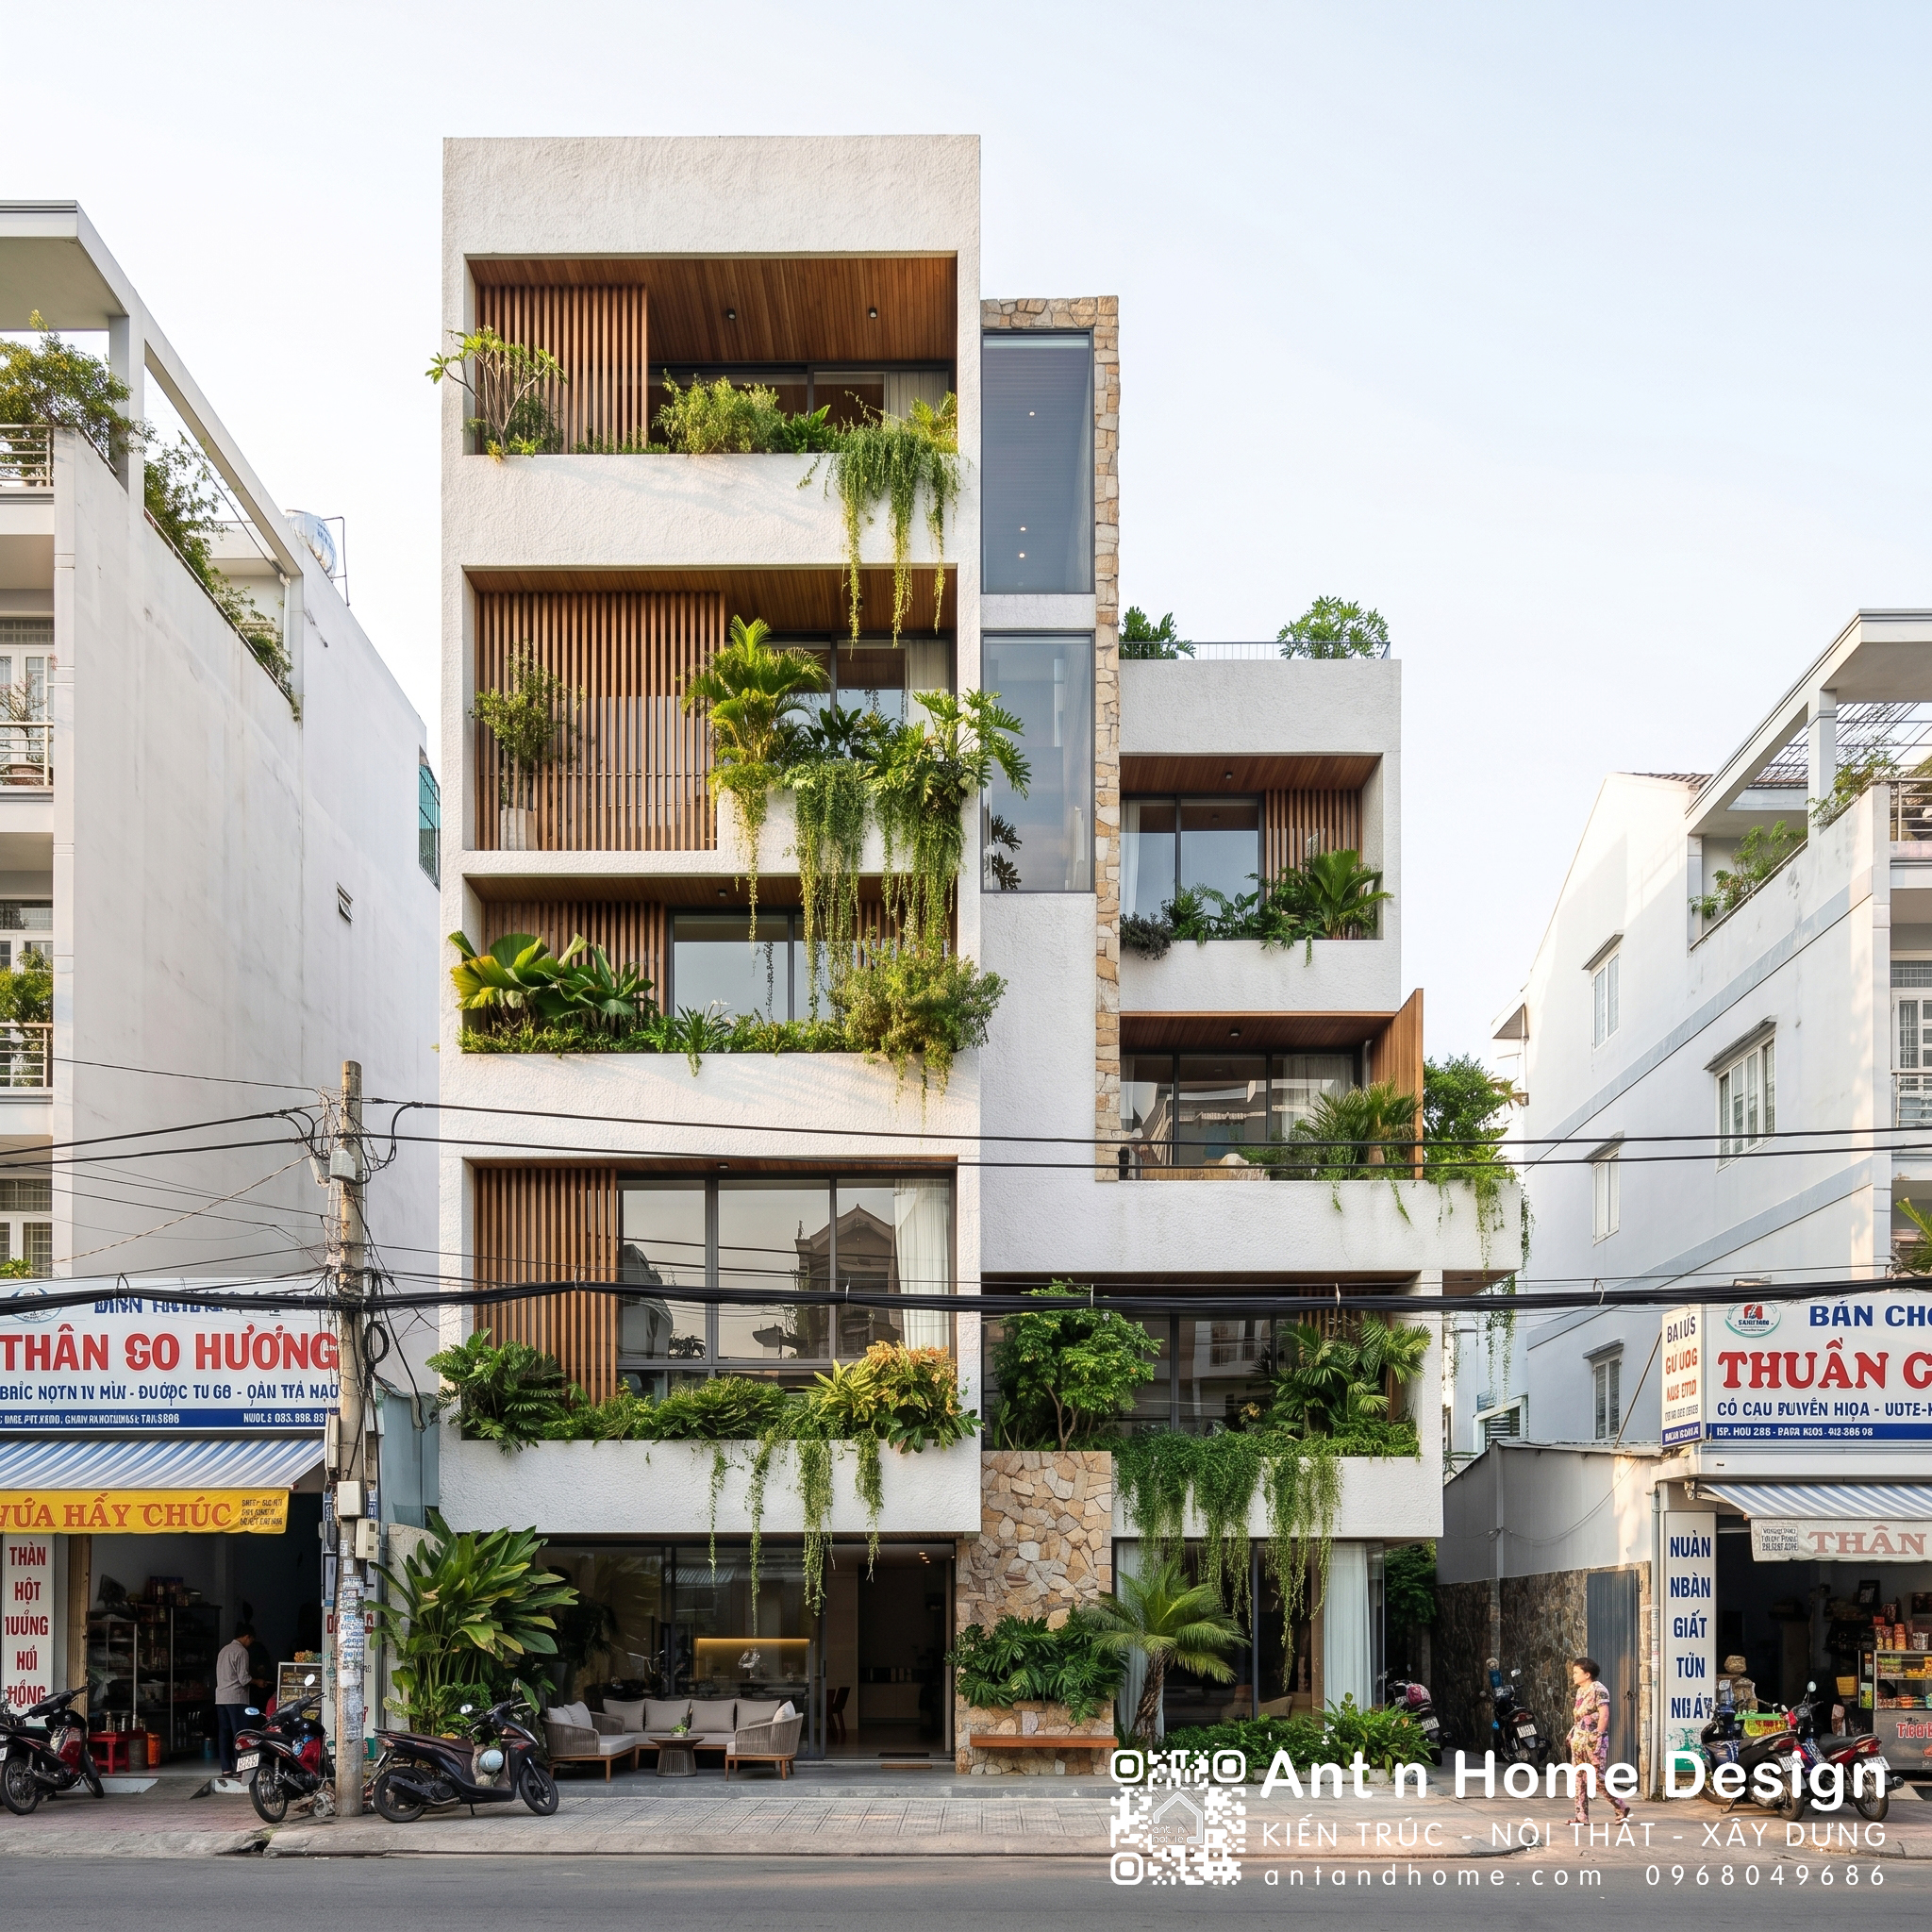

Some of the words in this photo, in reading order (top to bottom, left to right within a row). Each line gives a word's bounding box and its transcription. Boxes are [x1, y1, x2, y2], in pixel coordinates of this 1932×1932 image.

[1810, 1300, 1873, 1326] BÁN
[1885, 1306, 1932, 1326] CH
[0, 1324, 109, 1371] THÂN
[1807, 1525, 1927, 1555] THÂN
